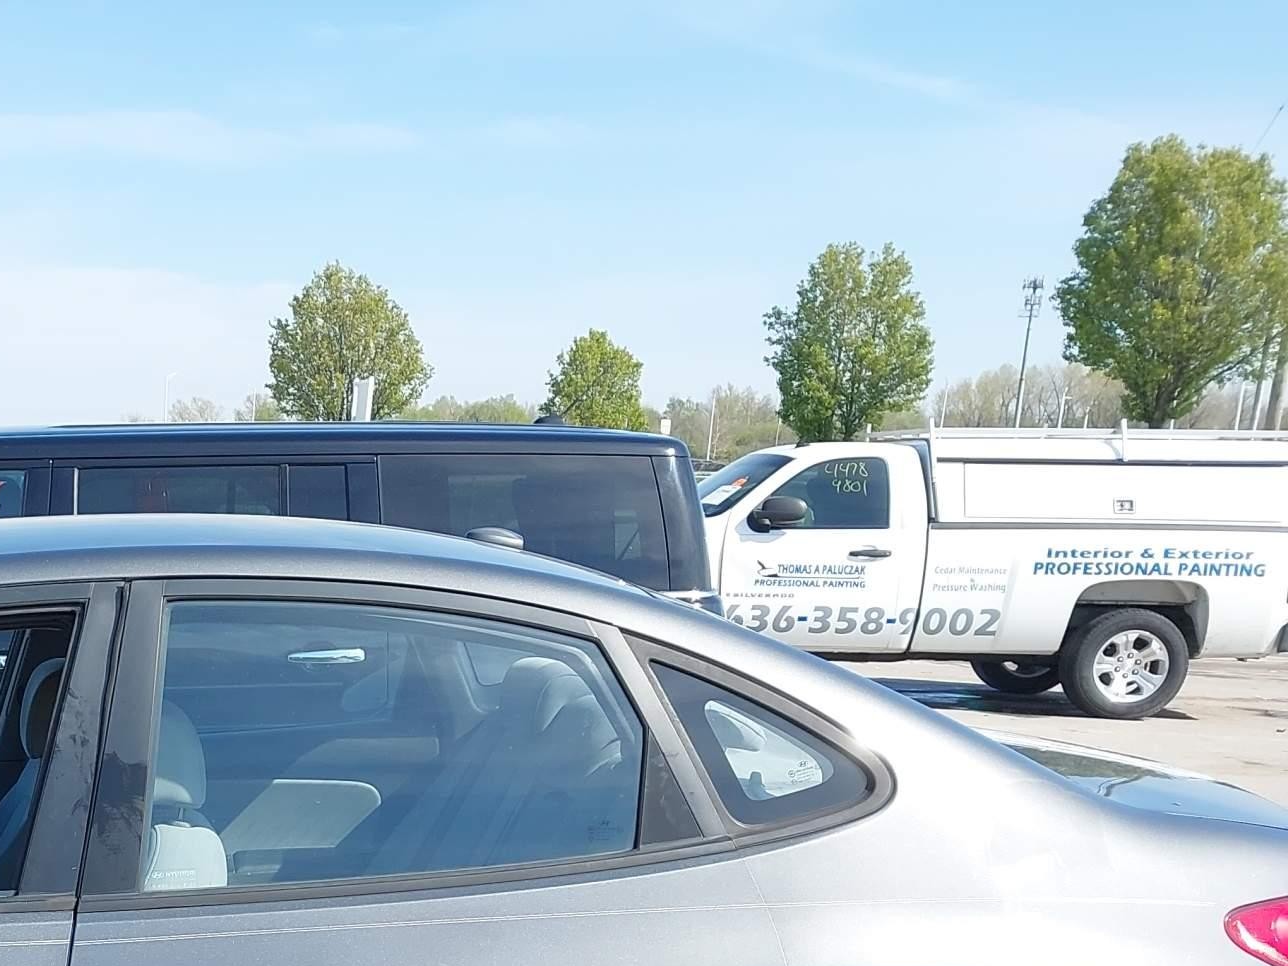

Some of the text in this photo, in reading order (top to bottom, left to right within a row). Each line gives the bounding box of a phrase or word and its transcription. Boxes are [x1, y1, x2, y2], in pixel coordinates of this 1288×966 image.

[824, 461, 869, 478] 4478
[1046, 547, 1255, 560] Interior & Exterior
[778, 563, 866, 576] THOMAS A PALUCZAK
[958, 566, 1008, 576] Maintenance
[1033, 561, 1266, 577] PROFESSIONAL PAINTING
[754, 578, 866, 589] PROFESSIONAL PAINTING
[932, 583, 1007, 593] Pressure Washing
